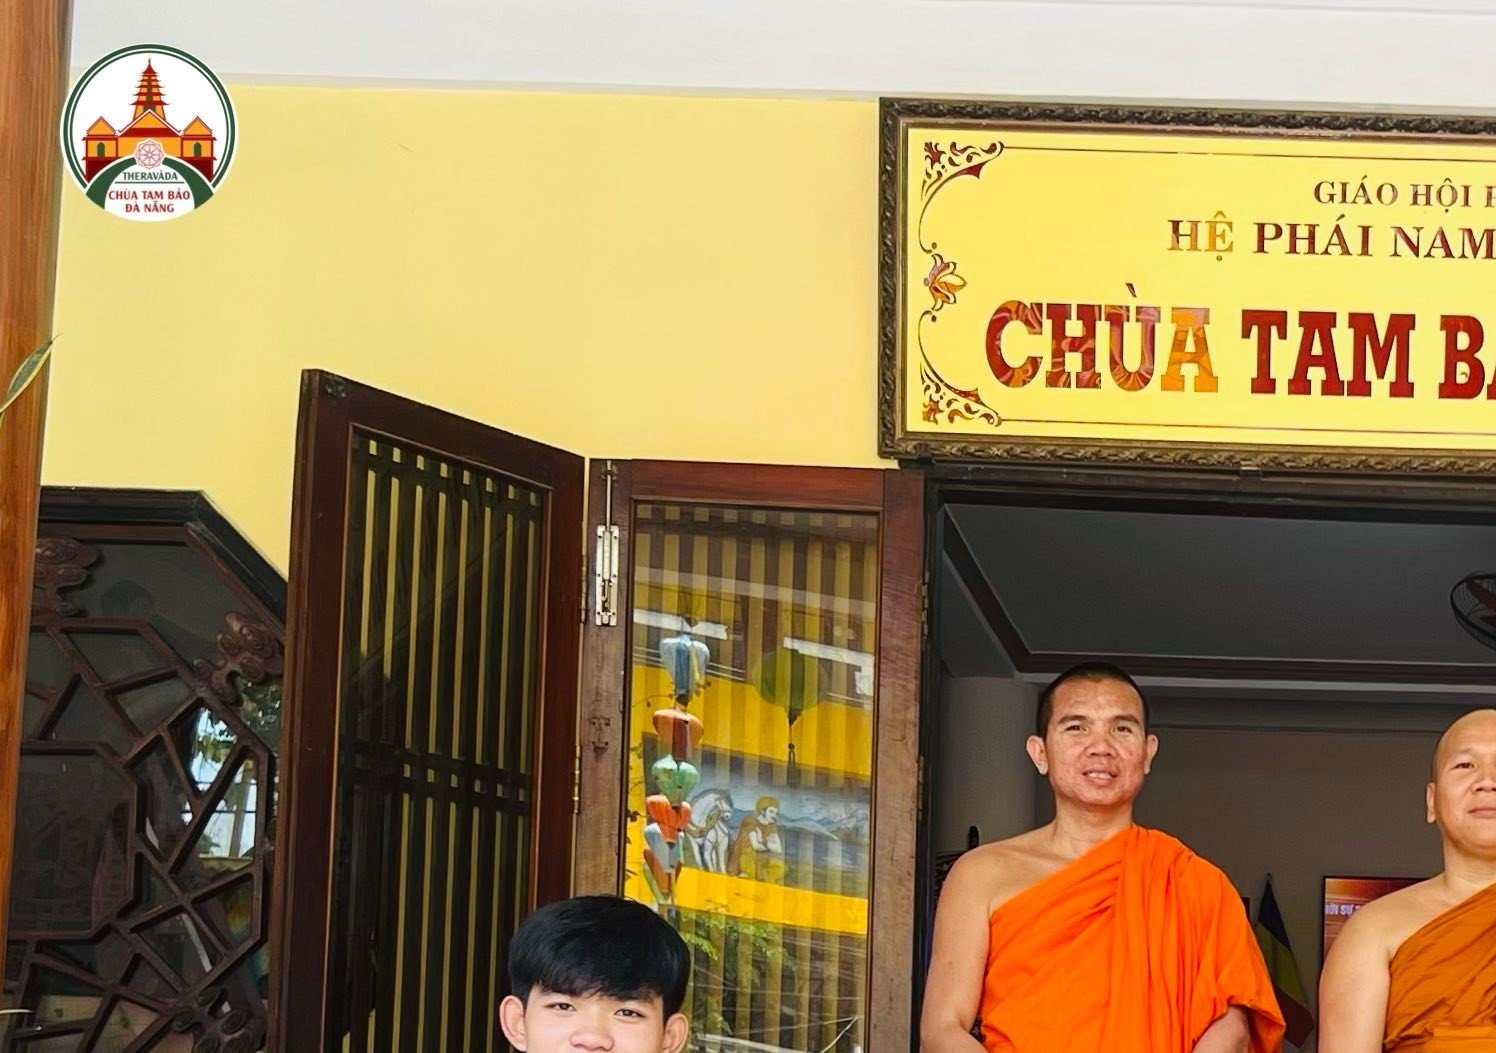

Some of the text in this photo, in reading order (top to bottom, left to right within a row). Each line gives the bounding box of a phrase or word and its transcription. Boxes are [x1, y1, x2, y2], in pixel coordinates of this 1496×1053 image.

[1314, 174, 1399, 206] GIÁO
[1409, 178, 1471, 212] HỘI
[1168, 211, 1234, 262] HỆ
[1252, 214, 1373, 257] PHÁI
[985, 282, 1219, 393] CHÙA
[1241, 309, 1417, 398] TAM
